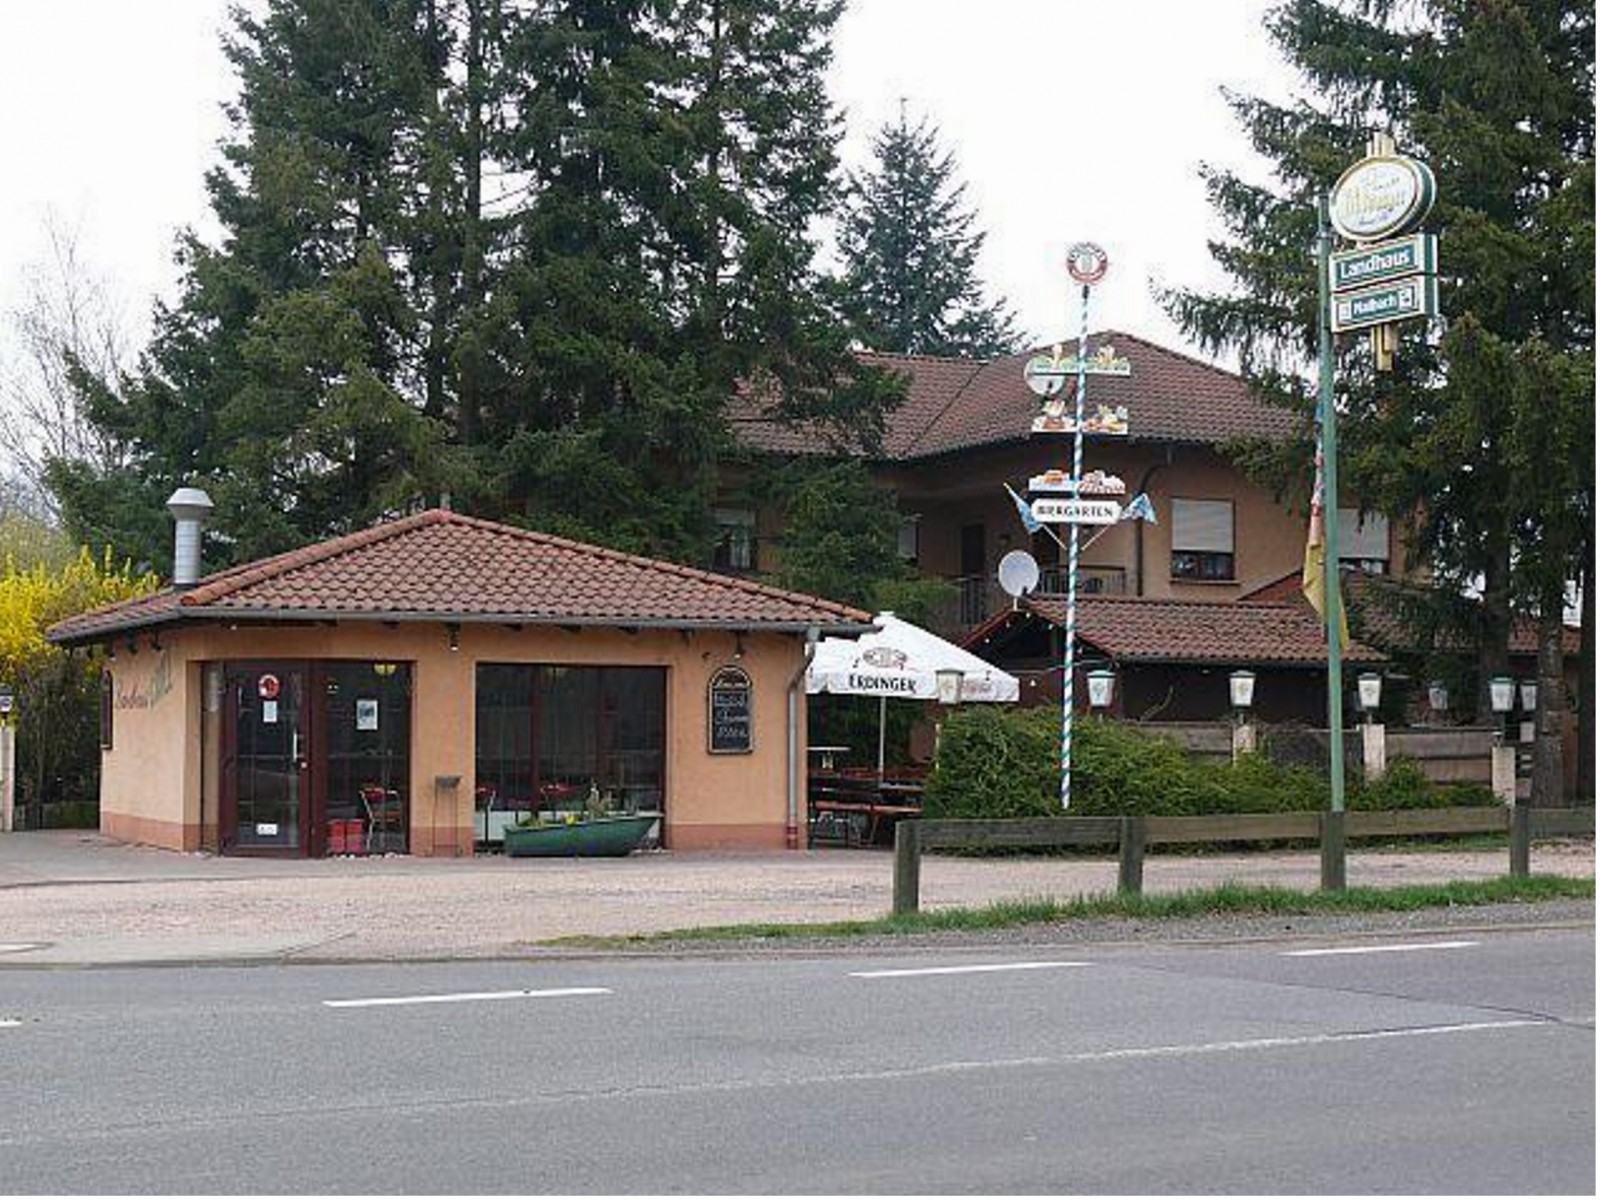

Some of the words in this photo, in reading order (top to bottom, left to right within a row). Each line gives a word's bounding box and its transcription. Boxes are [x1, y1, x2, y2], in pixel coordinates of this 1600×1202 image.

[1341, 248, 1410, 278] Landhaus
[1036, 505, 1114, 518] BIERGARTEN
[849, 674, 917, 693] ERDINGER
